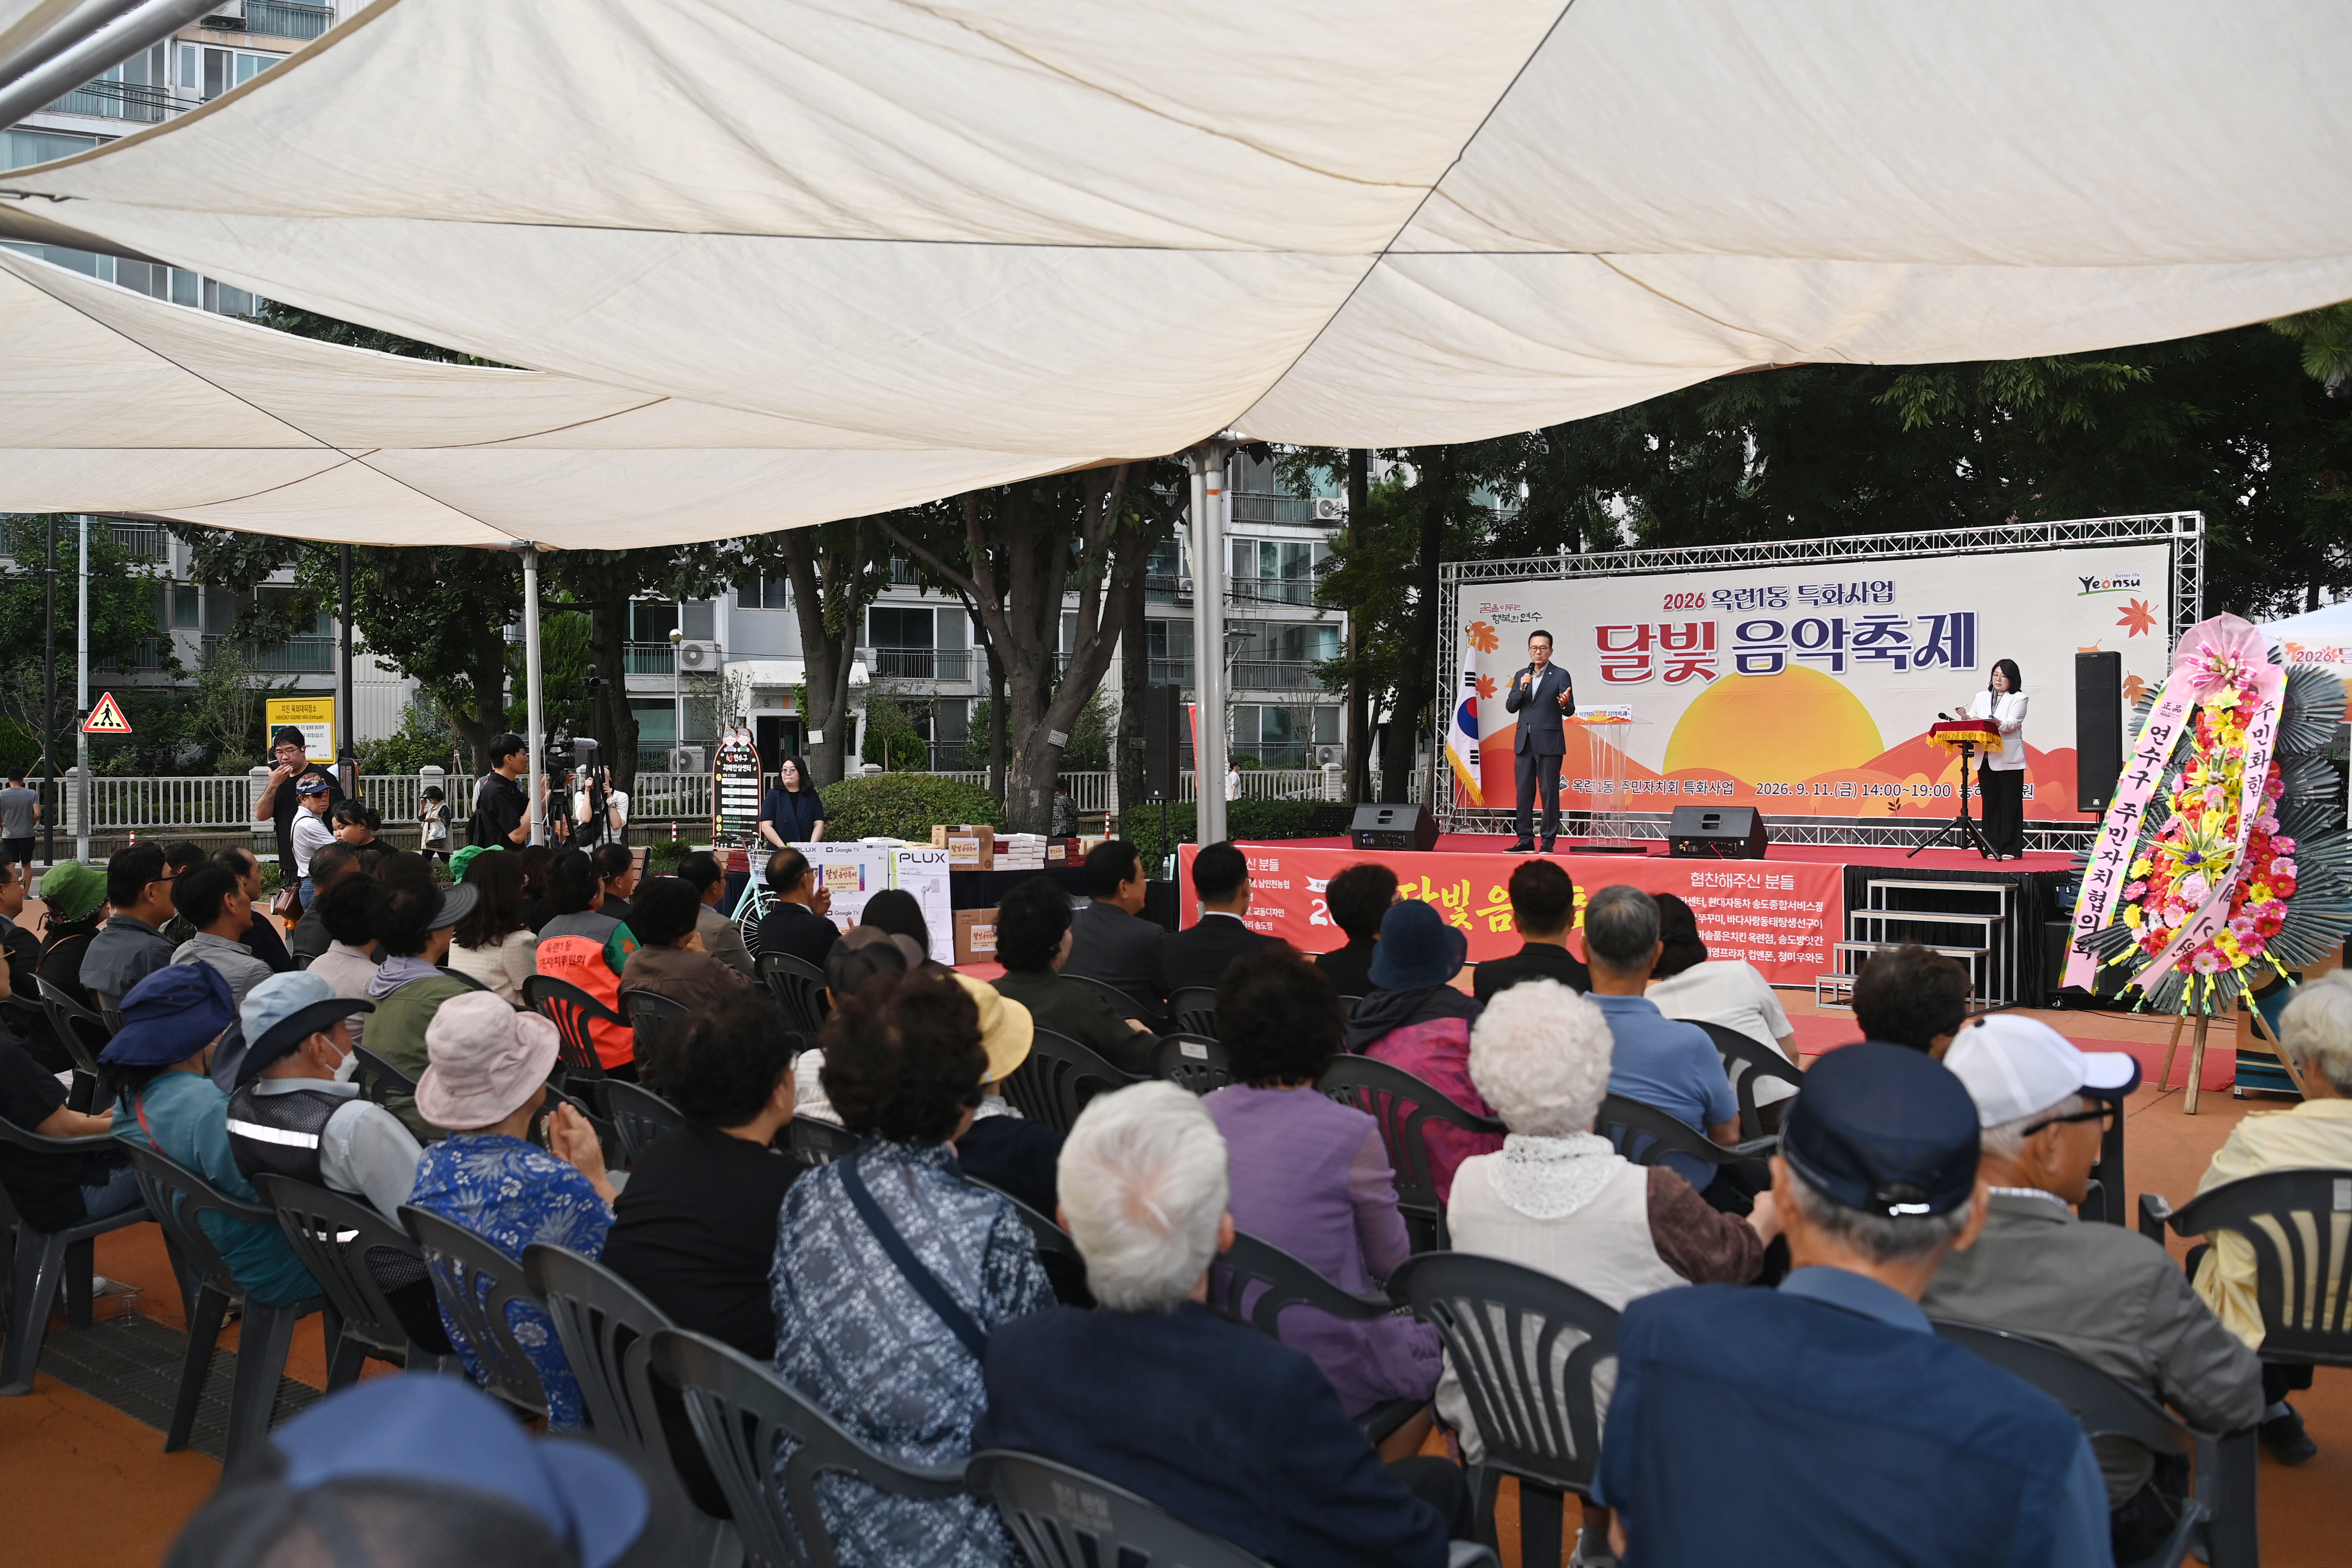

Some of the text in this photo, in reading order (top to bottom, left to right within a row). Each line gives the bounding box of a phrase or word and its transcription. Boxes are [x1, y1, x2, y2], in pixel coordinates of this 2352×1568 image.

[2078, 575, 2140, 593] Yeonsu
[1662, 579, 1896, 612] 2026 옥련1동 특화사업
[1479, 603, 1499, 613] 꿈을
[1491, 612, 1543, 624] 행복한 연수
[1593, 609, 1979, 685] 달빛 음악축제
[2296, 650, 2332, 662] 2026
[281, 704, 317, 713] 지진 옥외대피장소
[764, 699, 770, 708] 5
[2161, 702, 2182, 713] 正品
[2246, 700, 2275, 800] 주민화합
[2127, 724, 2171, 789] 연수구
[722, 764, 751, 772] 치매안심센터
[1572, 779, 1734, 796] 옥련1동 주민자치회 특화사업
[1755, 782, 1793, 796] 2026.
[1795, 782, 1808, 796] 9.
[1861, 783, 1951, 798] 14:00~19:00
[899, 853, 946, 863] PLUX
[1259, 858, 1279, 871] 분들
[826, 869, 857, 880] 달빛 음악축제
[1690, 871, 1795, 890] 협찬해주신 분들
[1258, 879, 1290, 889] 남인천농협
[1315, 882, 1328, 890] 옥련
[1677, 896, 1824, 912] 카센터, 현대자동차 송도종합서비스점
[1253, 907, 1285, 918] 교동디자인
[1254, 921, 1273, 931] 송도점
[1726, 914, 1823, 929] 바다사랑동태탕생선구이
[1697, 930, 1824, 946] 마솥품은치킨 옥련점, 송도방앗간
[1748, 949, 1777, 962] 컴앤폰,
[1777, 951, 1824, 964] 청미우와돈
